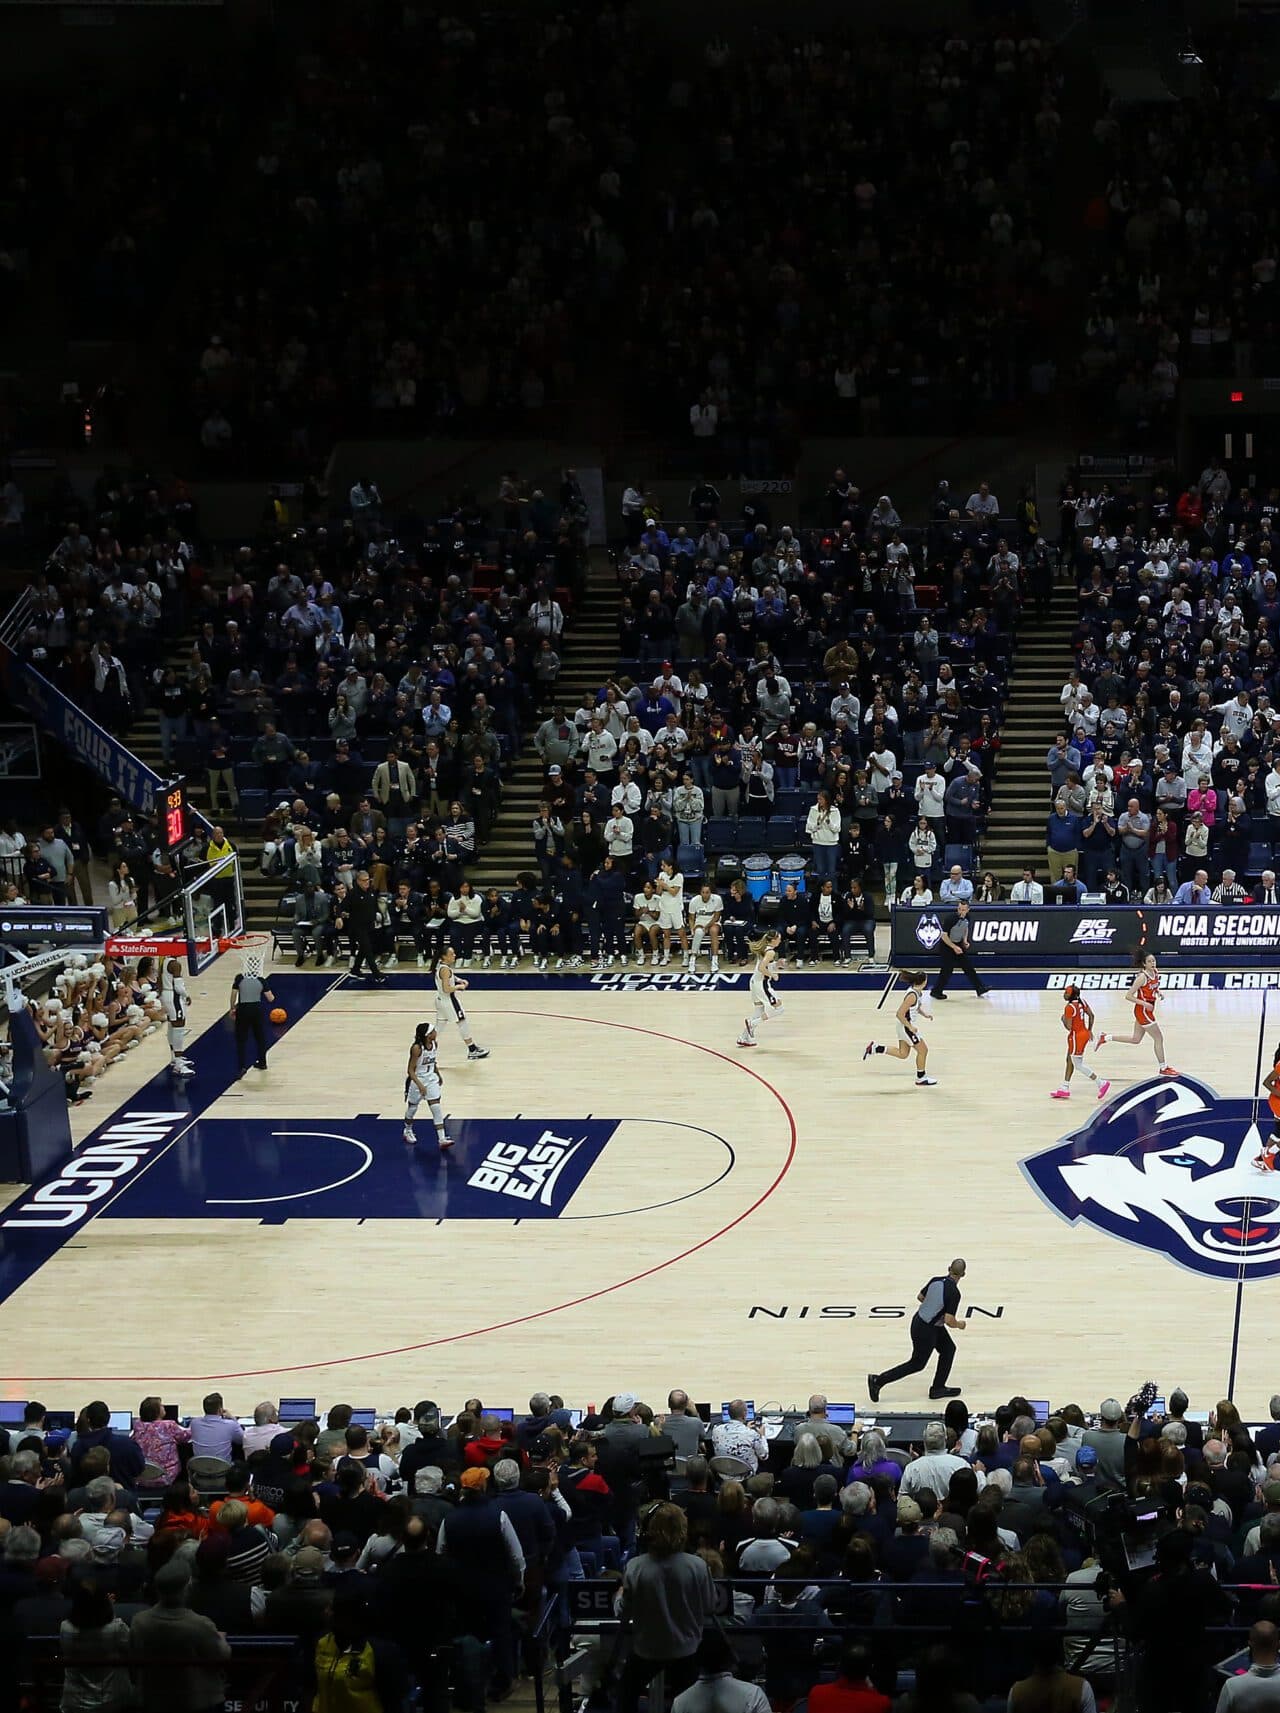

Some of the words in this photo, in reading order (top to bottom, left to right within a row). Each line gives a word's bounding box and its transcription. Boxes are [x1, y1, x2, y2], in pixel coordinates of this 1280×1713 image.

[64, 707, 112, 784] FOUR
[114, 754, 139, 801] IT
[971, 920, 1040, 942] UCONN
[1071, 928, 1117, 937] EAST
[1076, 918, 1109, 930] BIG
[1157, 914, 1208, 936] NCAA
[1180, 936, 1209, 946] HOSTED
[1210, 936, 1218, 946] BY
[1219, 936, 1235, 946] THE
[1236, 936, 1279, 946] UNIVERSITY
[589, 973, 741, 984] UCONN
[1046, 973, 1217, 990] BASKEBALL
[0, 1111, 190, 1229] UCONN
[466, 1141, 529, 1193] BIG
[501, 1130, 571, 1201] EAST
[748, 1305, 1004, 1319] NISSN
